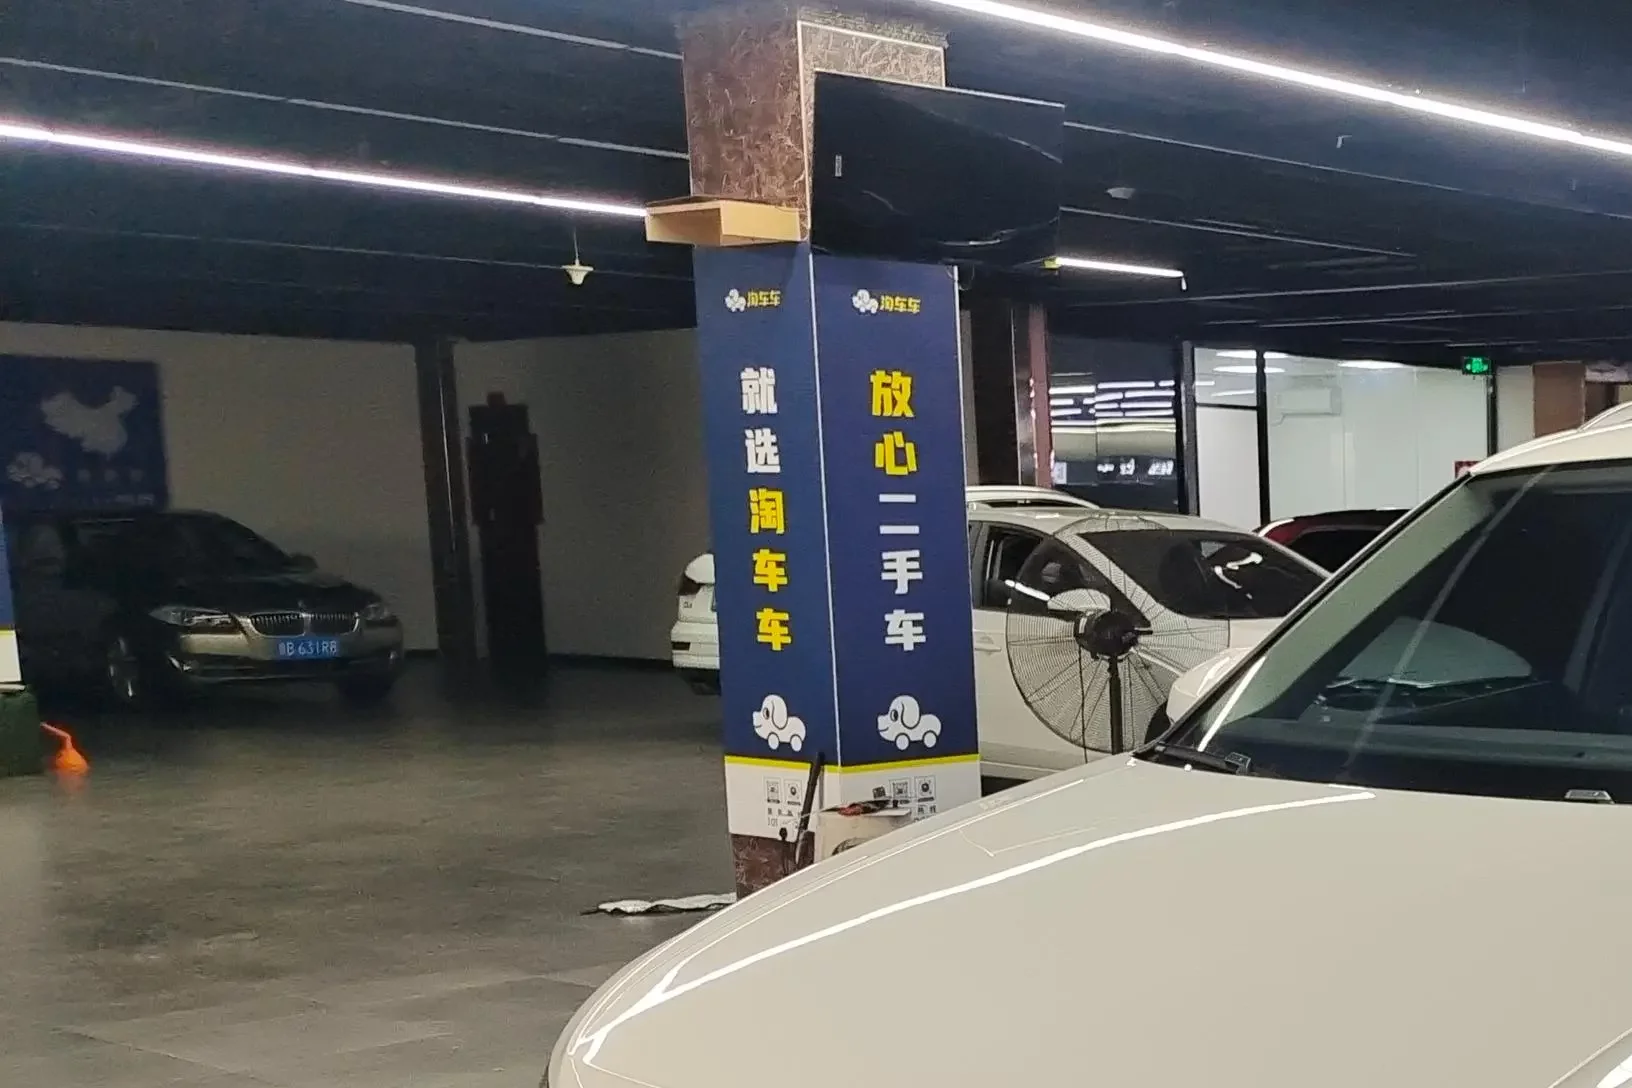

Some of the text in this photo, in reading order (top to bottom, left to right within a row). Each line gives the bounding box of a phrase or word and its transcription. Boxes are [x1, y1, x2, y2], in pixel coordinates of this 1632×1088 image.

[740, 366, 792, 650] 就选淘车车
[869, 369, 926, 651] 放心二手车
